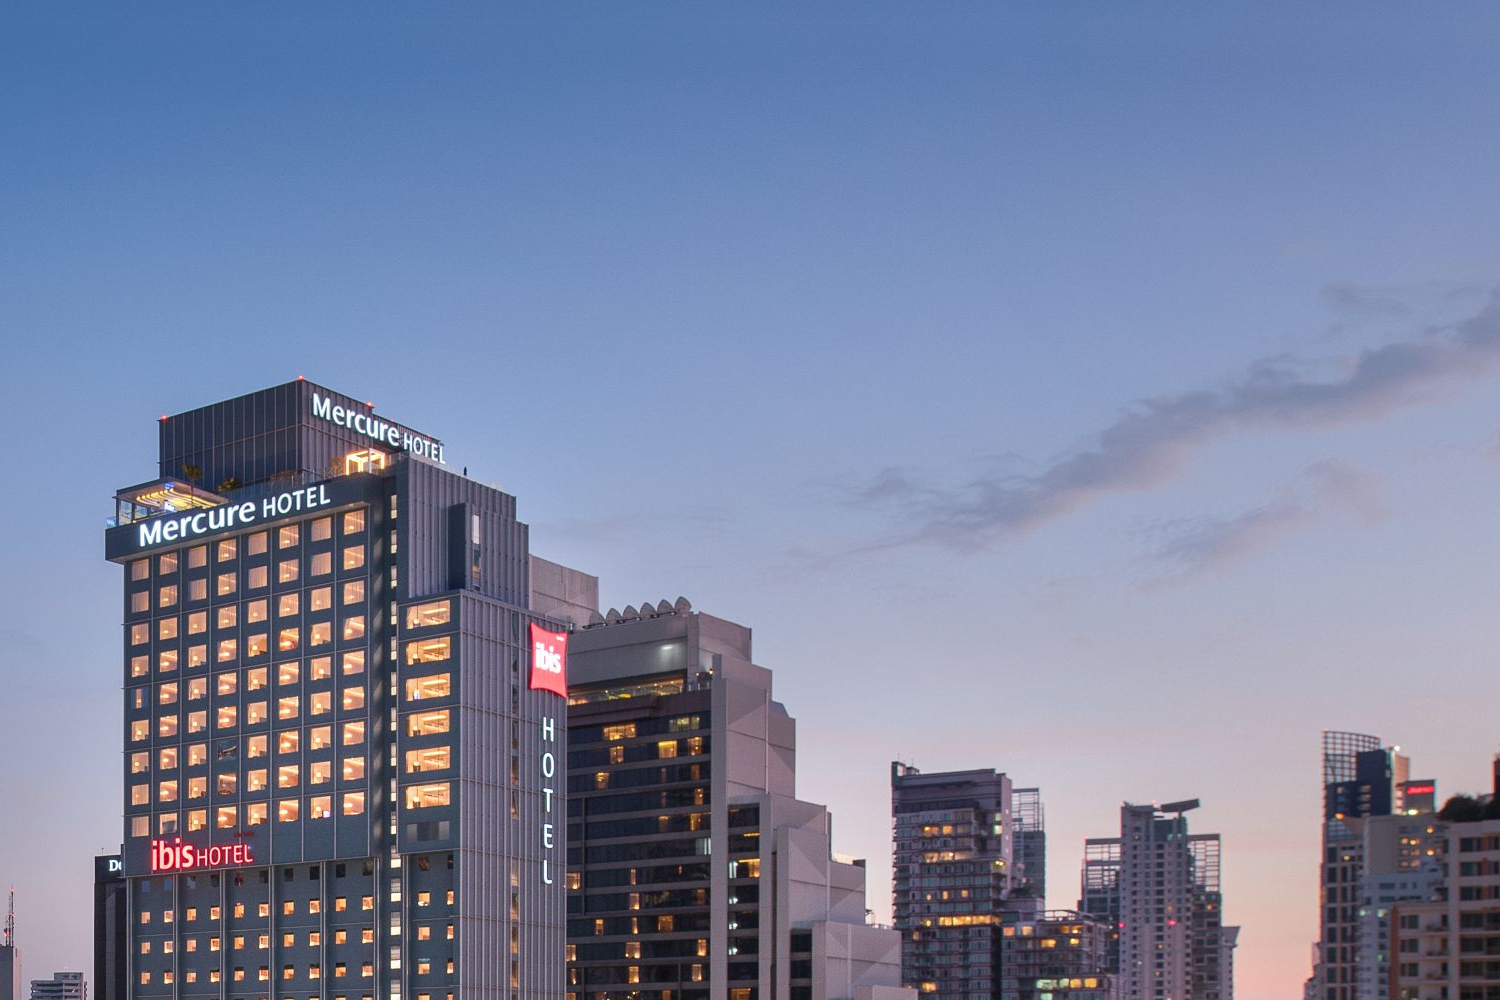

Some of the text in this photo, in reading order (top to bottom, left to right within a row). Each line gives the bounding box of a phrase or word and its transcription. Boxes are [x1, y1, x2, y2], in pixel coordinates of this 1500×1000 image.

[312, 392, 446, 465] Mercure HOTEL
[139, 484, 331, 547] Mercure HOTEL
[535, 641, 562, 675] ibis
[542, 716, 555, 885] HOTEL
[151, 837, 254, 871] ibis HOTEL
